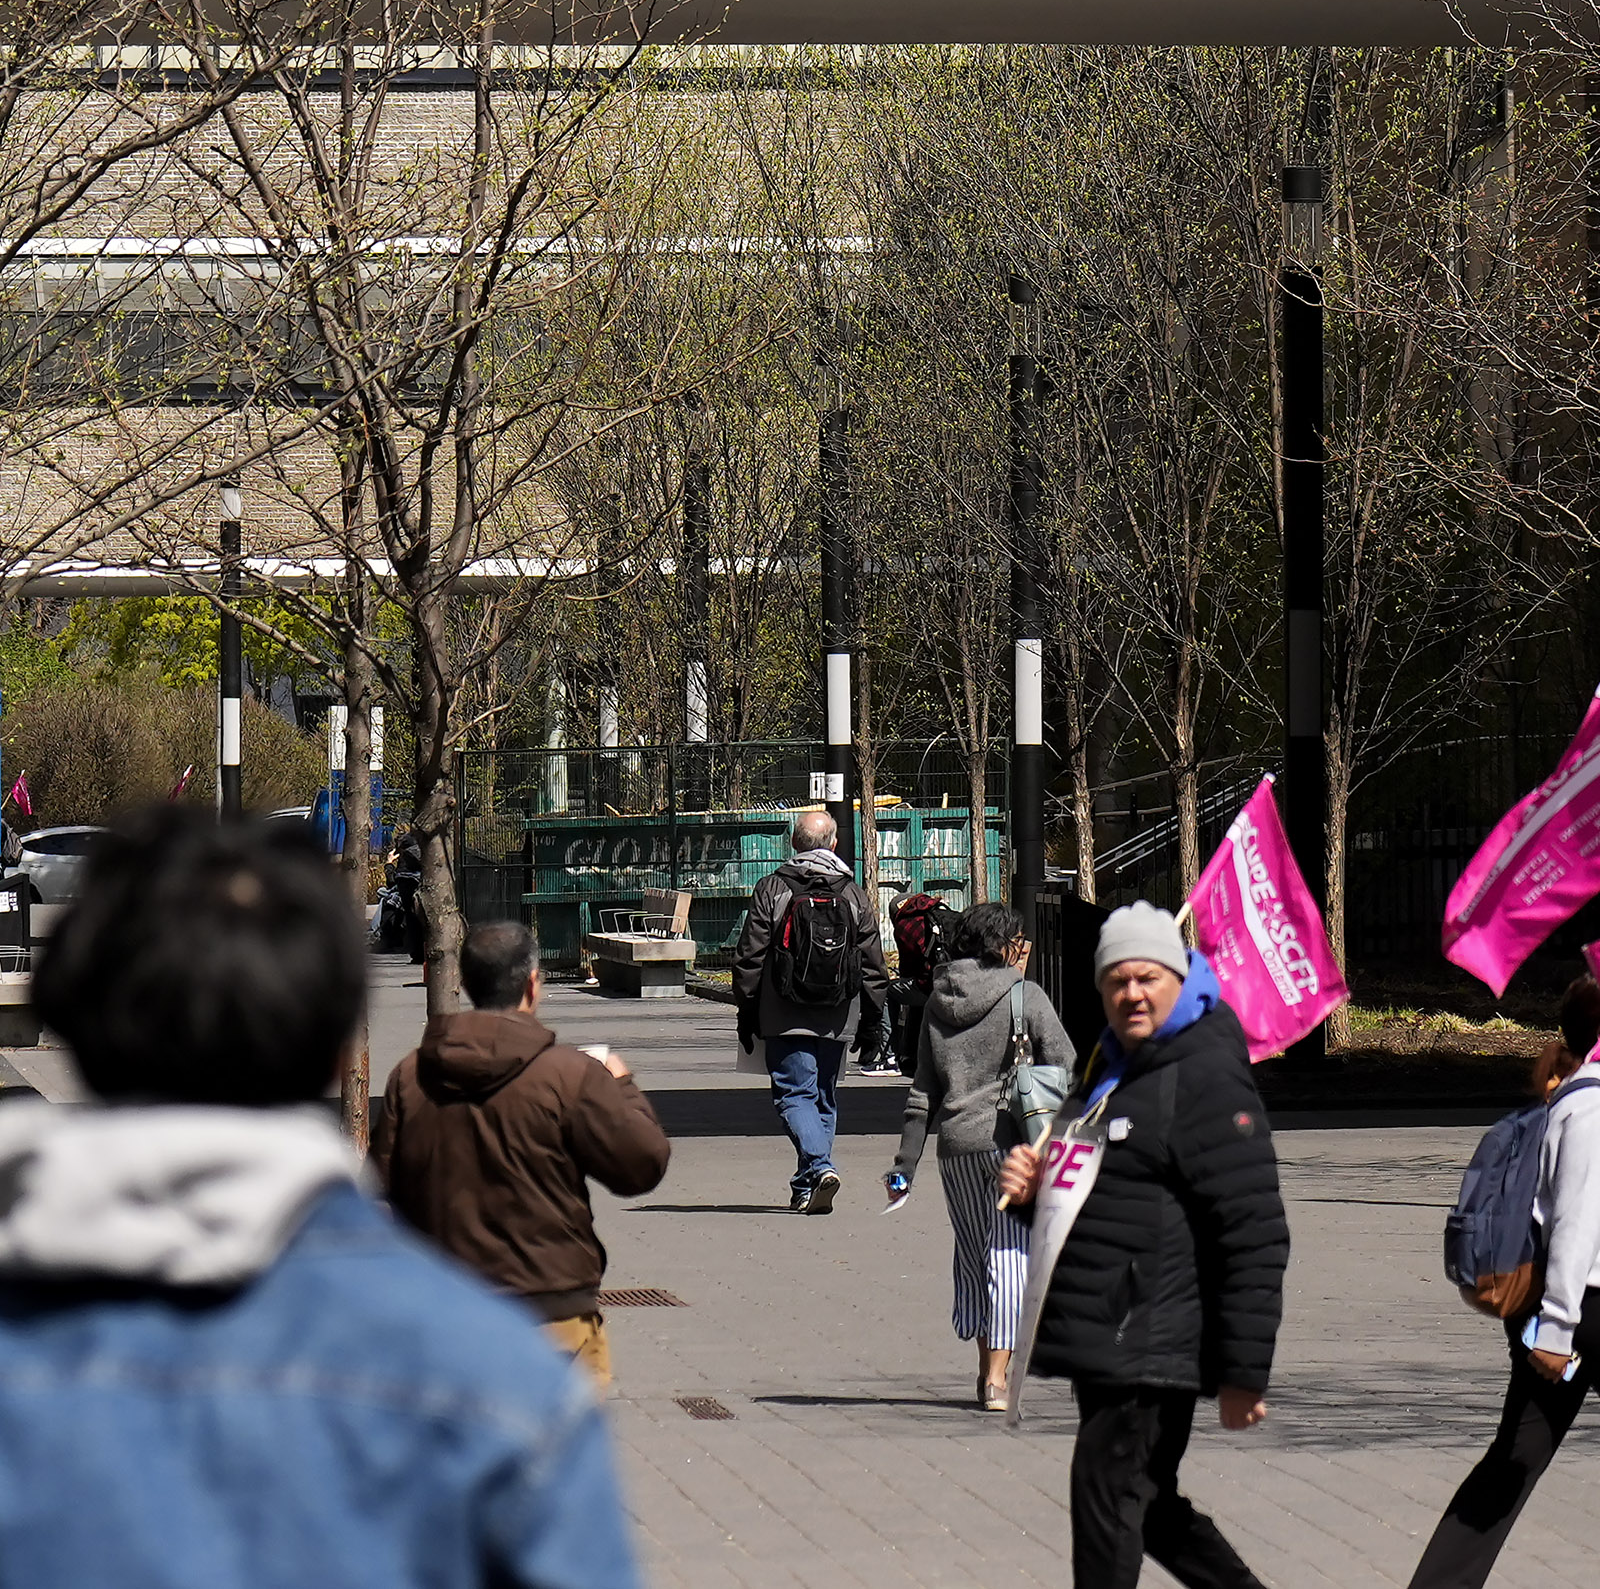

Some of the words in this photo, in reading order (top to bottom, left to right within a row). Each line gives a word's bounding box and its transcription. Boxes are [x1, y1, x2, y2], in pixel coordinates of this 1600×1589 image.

[1242, 825, 1277, 905] CUPE
[1269, 922, 1320, 996] SCFP
[1040, 1140, 1095, 1189] PE
